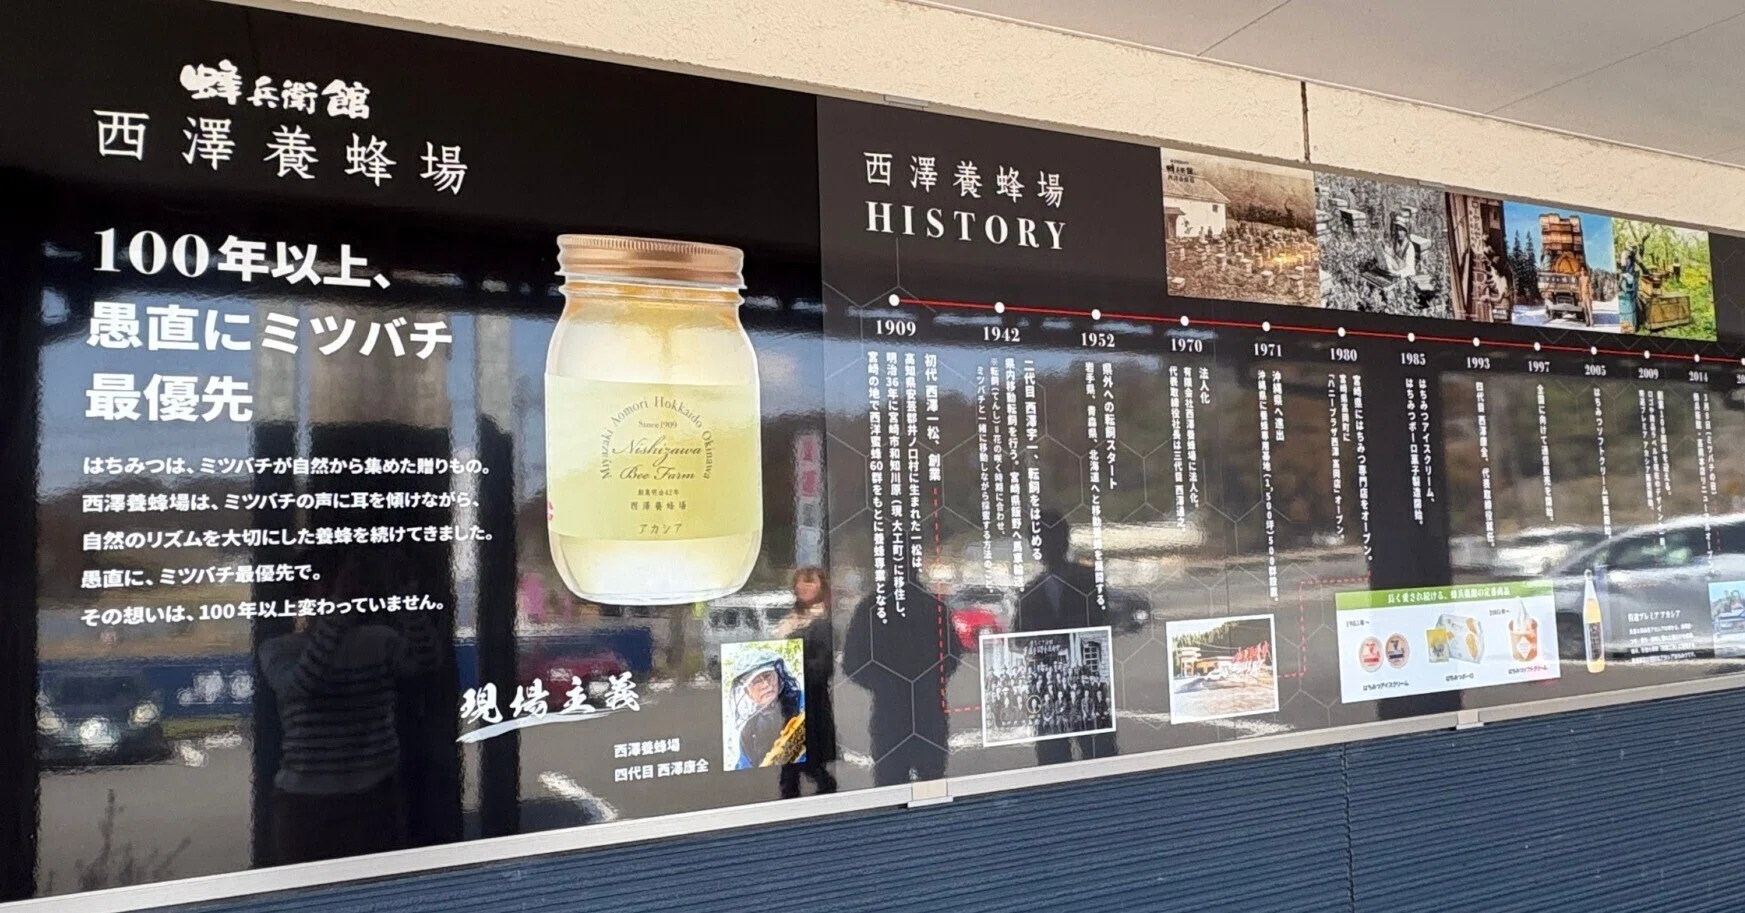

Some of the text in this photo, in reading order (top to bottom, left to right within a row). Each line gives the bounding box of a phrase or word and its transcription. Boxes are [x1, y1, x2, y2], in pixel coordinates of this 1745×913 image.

[180, 60, 370, 120] 蜂兵衛館
[93, 109, 468, 195] 西澤養蜂場
[863, 152, 1064, 208] 西澤養蜂場
[865, 201, 1066, 250] HISTORY
[93, 227, 391, 289] 100年以上、
[87, 301, 452, 360] 愚直にミツバチ
[875, 320, 916, 336] 1909
[983, 326, 1020, 342] 1942
[1081, 332, 1115, 348] 1952
[1170, 337, 1202, 353] 1970
[1253, 343, 1282, 357] 1971
[1330, 348, 1357, 361] 1980
[1401, 353, 1426, 365] 1985
[1467, 357, 1490, 369] 1993
[925, 354, 937, 381] 初代
[1528, 361, 1550, 373] 1997
[1584, 364, 1606, 376] 2005
[1638, 368, 1659, 379] 2009
[1689, 371, 1708, 382] 2014
[1024, 360, 1036, 398] 二代目
[1199, 367, 1210, 404] 法人化
[85, 373, 253, 422] 最優先
[1102, 363, 1117, 489] 県外への転飼スタート
[600, 396, 714, 480] Miyazaki Aomori Hokkaido Okinawa
[612, 435, 702, 467] Nishizawa
[83, 457, 490, 476] はちみつは、ミツバチが自然から集めた贈りもの。
[619, 466, 695, 480] Bee Farm
[82, 491, 480, 513] 西澤養蜂場は、ミツバチの声に耳を傾けながら、
[82, 526, 493, 551] 自然のリズムを大切にした養蜂を続けてきました。
[639, 523, 682, 534] アカシア
[80, 564, 321, 589] 愚直に、ミツバチ最優先で。
[80, 595, 445, 627] その想いは、100年以上変わっていません。
[459, 671, 640, 724] 現場主義
[614, 738, 681, 758] 西澤養蜂場
[614, 760, 709, 782] 四代目 西澤康全
